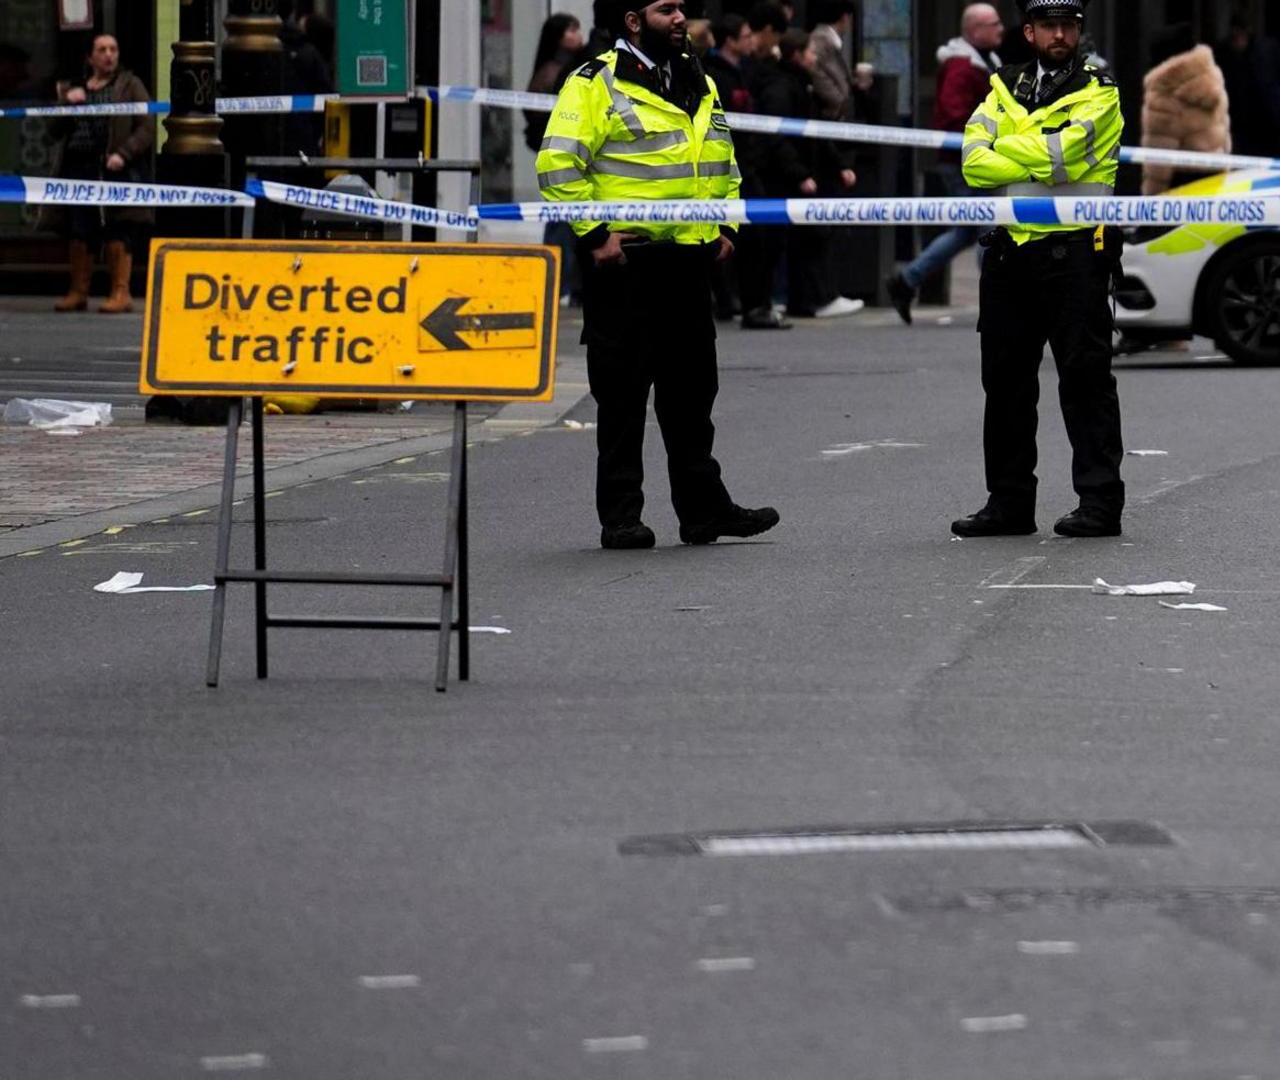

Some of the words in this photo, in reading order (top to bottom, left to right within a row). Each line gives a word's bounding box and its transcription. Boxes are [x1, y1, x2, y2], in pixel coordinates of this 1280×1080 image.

[373, 10, 382, 26] the
[284, 187, 340, 210] POLICE
[344, 199, 378, 216] LINE
[805, 201, 855, 221] POLICE
[858, 201, 890, 221] LINE
[893, 201, 914, 221] DO
[917, 201, 945, 221] NOT
[948, 201, 996, 221] CROSS
[1074, 201, 1124, 221] POLICE
[1127, 201, 1160, 221] LINE
[1162, 201, 1183, 221] DO
[1187, 201, 1215, 221] NOT
[1218, 201, 1265, 221] CROSS
[540, 206, 588, 223] POLICE
[591, 205, 624, 222] LINE
[625, 204, 646, 221] DO
[649, 204, 679, 221] NOT
[680, 203, 730, 221] CROSS
[183, 272, 408, 315] Diverted
[206, 324, 375, 364] traffic
